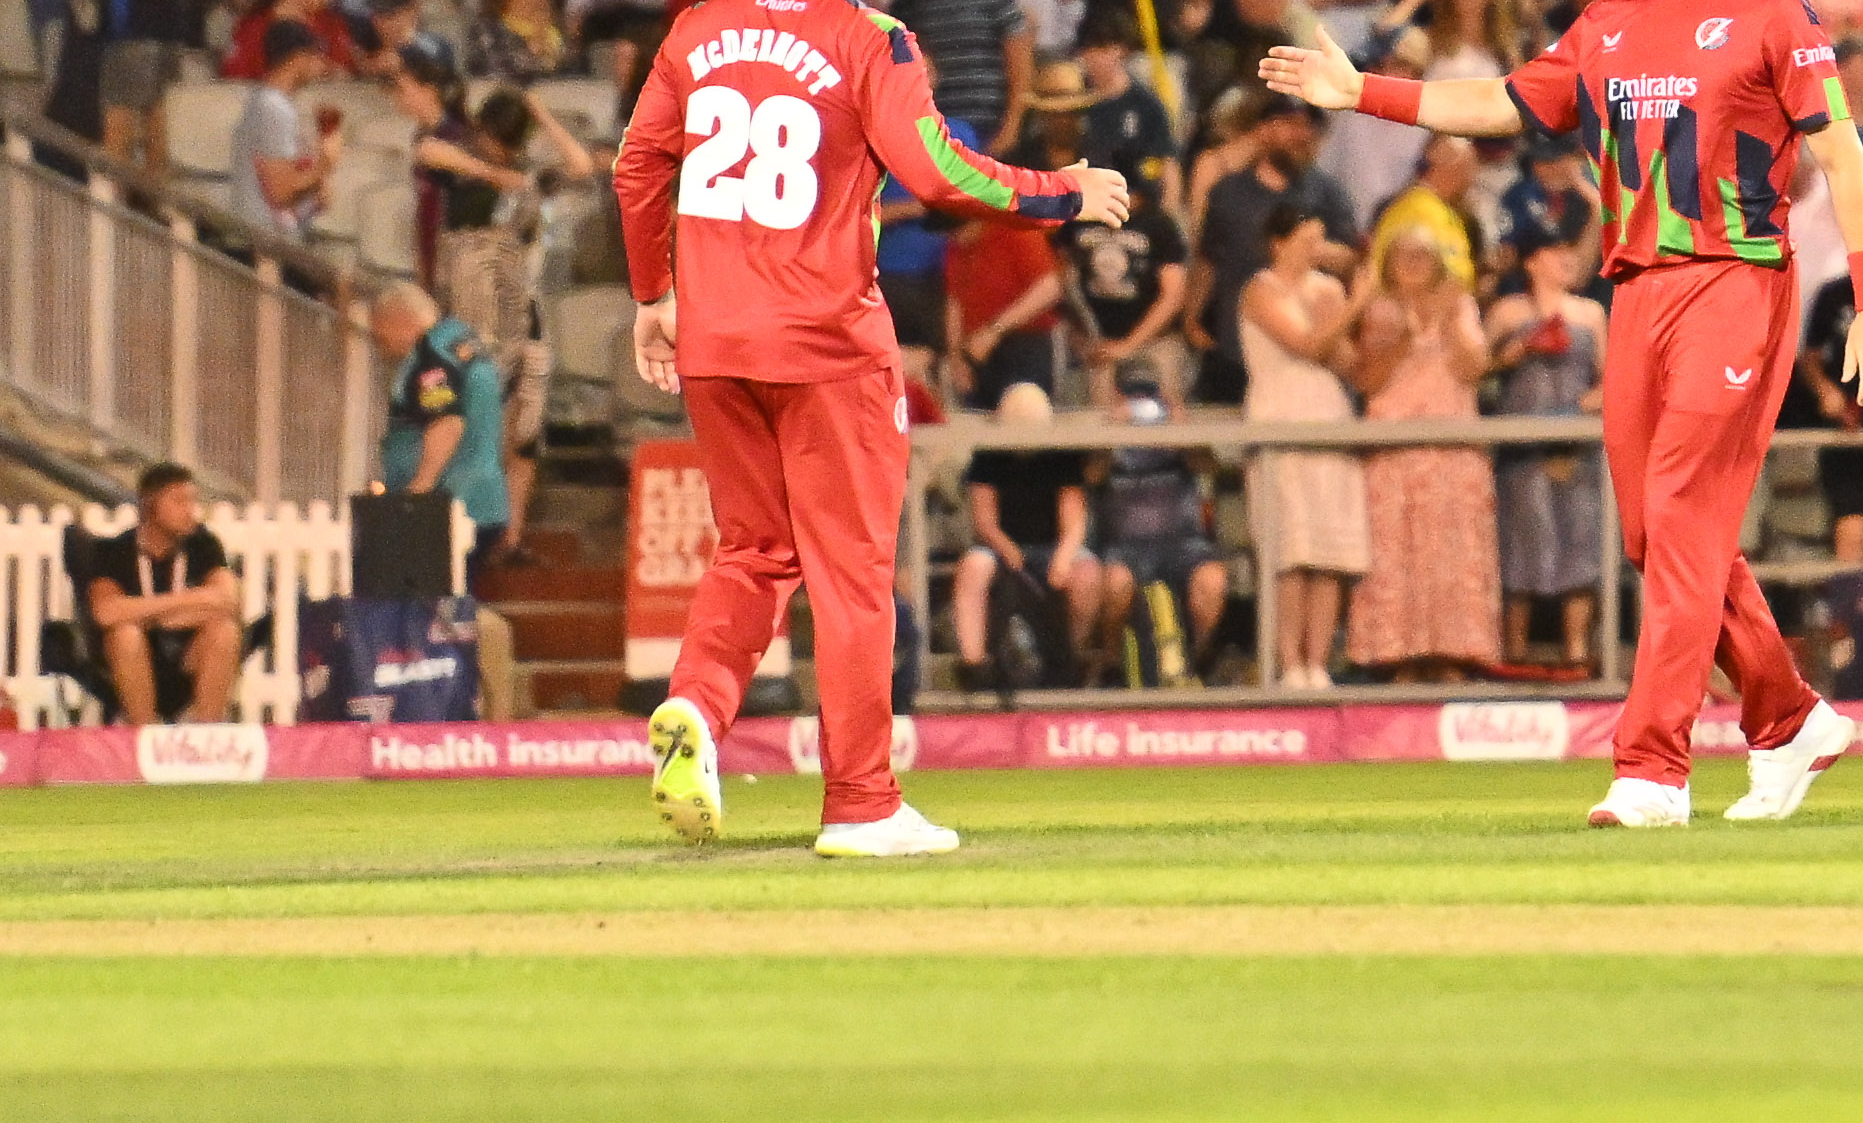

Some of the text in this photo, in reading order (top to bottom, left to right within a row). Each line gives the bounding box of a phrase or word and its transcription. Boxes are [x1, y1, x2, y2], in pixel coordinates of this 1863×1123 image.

[1608, 73, 1698, 102] Emirates
[678, 85, 822, 231] 28
[371, 732, 657, 769] Health insuran
[1047, 721, 1307, 757] Life insurance
